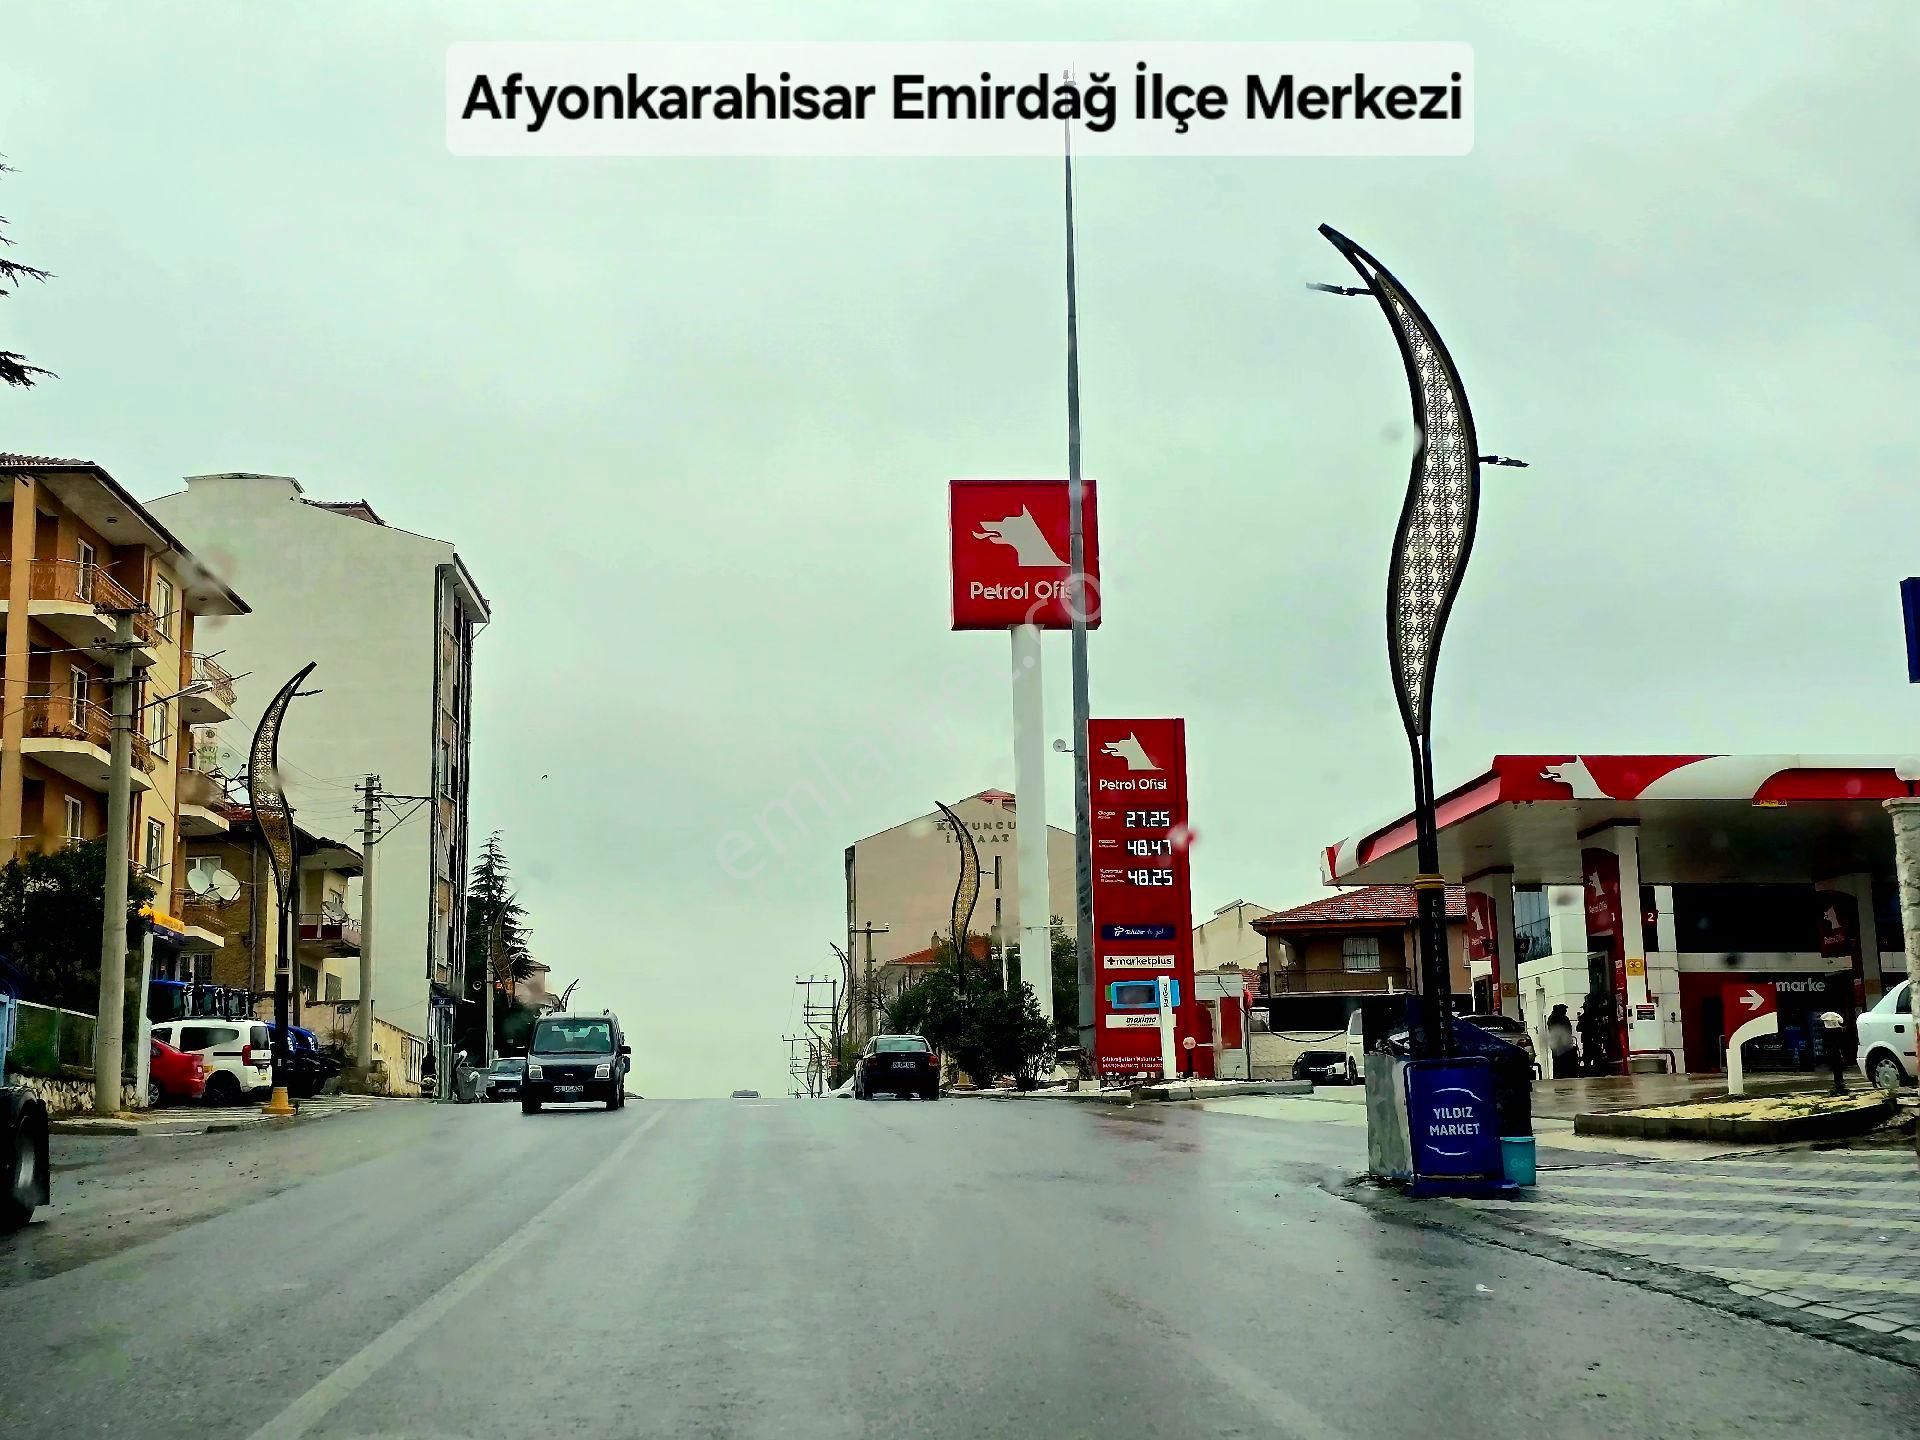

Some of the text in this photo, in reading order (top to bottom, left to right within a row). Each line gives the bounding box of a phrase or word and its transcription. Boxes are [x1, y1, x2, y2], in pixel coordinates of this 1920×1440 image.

[970, 580, 1072, 600] Petrol Ofis
[1099, 778, 1168, 791] Petrol Ofisi
[1126, 811, 1170, 828] 27.25
[1127, 839, 1172, 856] 48.47
[1127, 869, 1173, 886] 48.25
[1647, 912, 1655, 922] 2
[1776, 977, 1826, 992] marke
[1432, 1106, 1474, 1120] YILDIZ
[1429, 1123, 1480, 1136] MARKET
